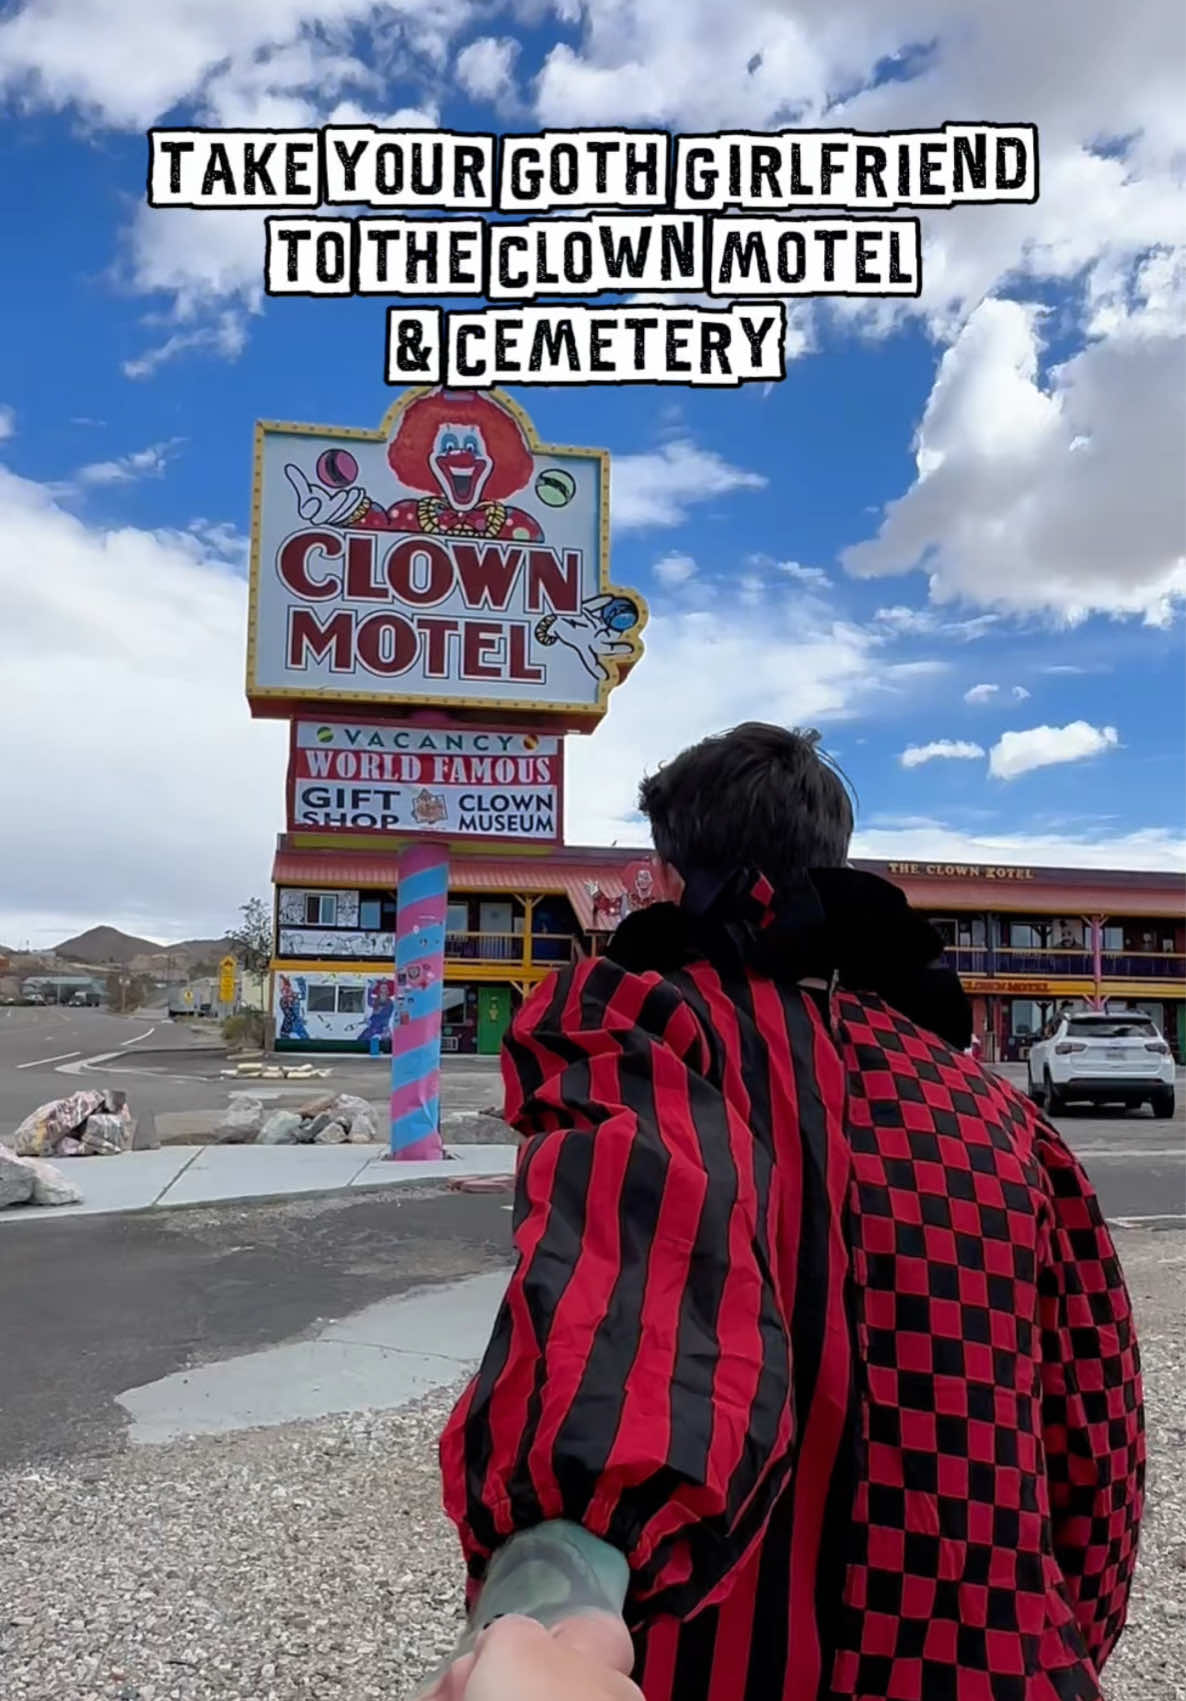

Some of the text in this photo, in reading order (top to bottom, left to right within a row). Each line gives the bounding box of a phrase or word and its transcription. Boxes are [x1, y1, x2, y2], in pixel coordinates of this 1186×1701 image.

[276, 529, 583, 616] CLOWN
[285, 606, 547, 685] MOTEL
[344, 728, 513, 751] VACANCY
[305, 750, 551, 784] WORLD FAMOUS
[301, 786, 401, 811] GIFT
[458, 793, 554, 813] CLOWN
[302, 810, 400, 829] SHOP
[458, 814, 555, 833] MUSEUM
[888, 862, 919, 875] THE
[926, 864, 979, 878] CLOWN
